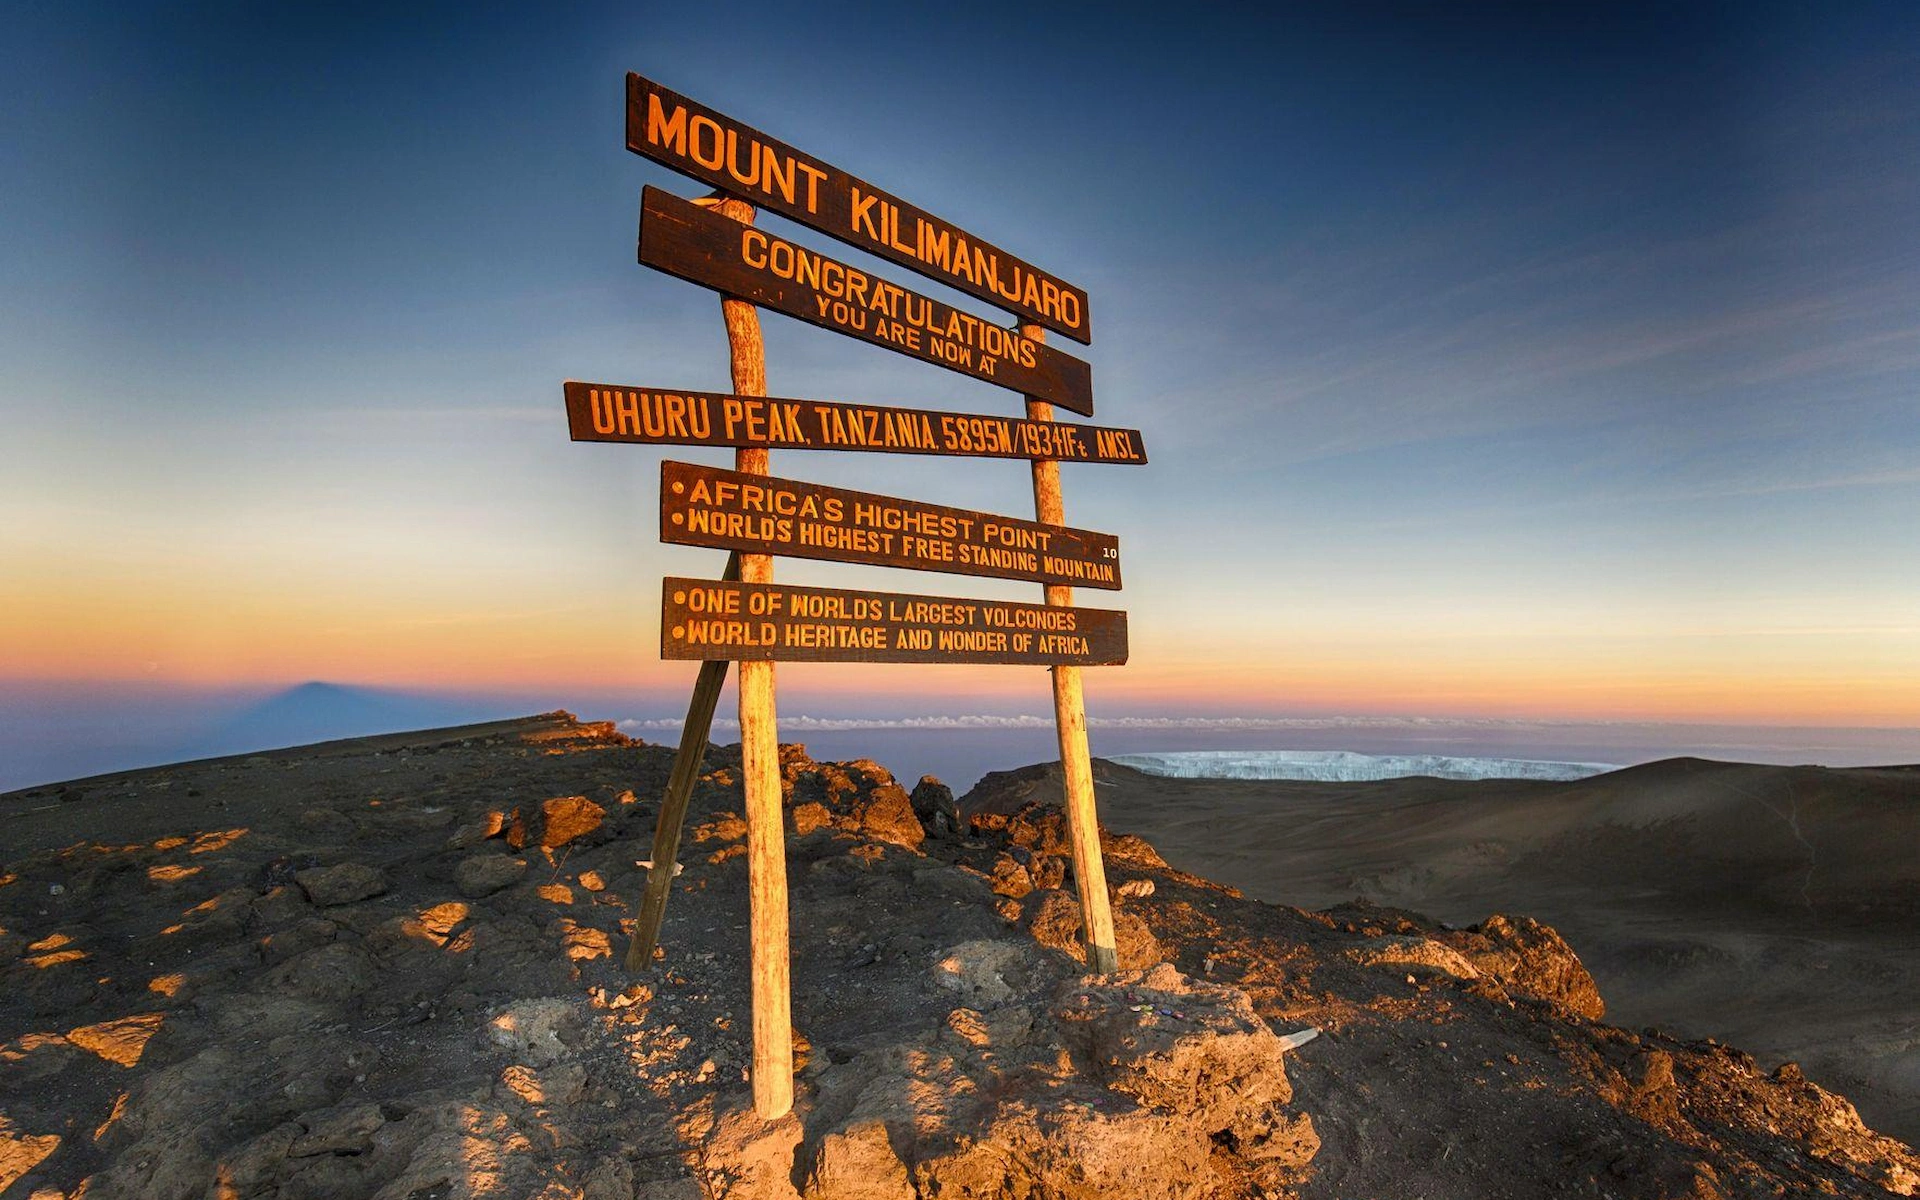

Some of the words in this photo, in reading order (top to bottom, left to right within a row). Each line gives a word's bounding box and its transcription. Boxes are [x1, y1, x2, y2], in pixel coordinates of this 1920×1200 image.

[648, 93, 827, 214] MOUNT
[851, 186, 1080, 329] KILIMANJARO
[742, 230, 1036, 368] CONGRATULATIONS
[816, 296, 866, 330] YOU
[875, 318, 920, 350] ARE
[931, 338, 971, 367] NOW
[979, 355, 997, 376] AT
[590, 389, 710, 439] UHURU
[723, 399, 811, 445] PEAK,
[1097, 430, 1138, 459] AMSL
[688, 508, 791, 542] WORLD'S
[800, 522, 893, 554] HIGHEST
[903, 534, 953, 561] FREE
[959, 543, 1037, 572] STANDING
[1044, 556, 1114, 582] MOUNTAIN
[689, 479, 844, 522] AFRICA'S
[855, 502, 973, 540] HIGHEST
[984, 523, 1051, 551] POINT
[687, 619, 776, 646] WORLD
[785, 623, 887, 649] HERITAGE
[896, 629, 932, 650] AND
[939, 631, 1007, 651] WONDER
[1012, 634, 1032, 653] OF
[1039, 635, 1089, 655] AFRICA
[688, 588, 740, 614] ONE
[750, 592, 782, 615] OF
[790, 594, 882, 621] WORLD'S
[889, 601, 976, 625] LARGEST
[983, 607, 1076, 631] VOLCONOES
